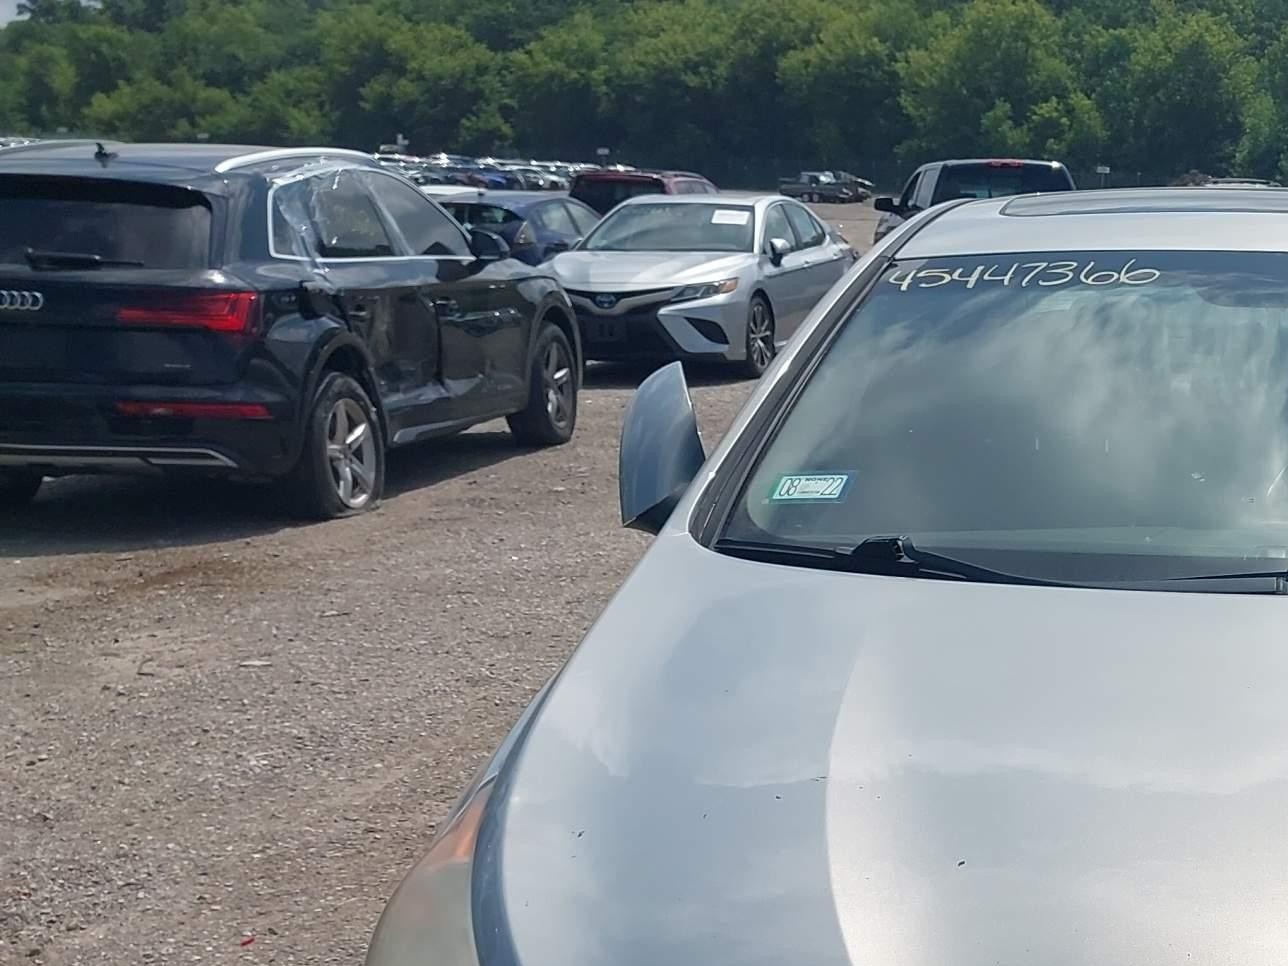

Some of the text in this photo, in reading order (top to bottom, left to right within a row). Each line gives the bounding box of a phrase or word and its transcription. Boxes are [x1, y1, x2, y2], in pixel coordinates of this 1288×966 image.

[889, 259, 1160, 290] 45447366
[779, 477, 844, 496] 08 22
